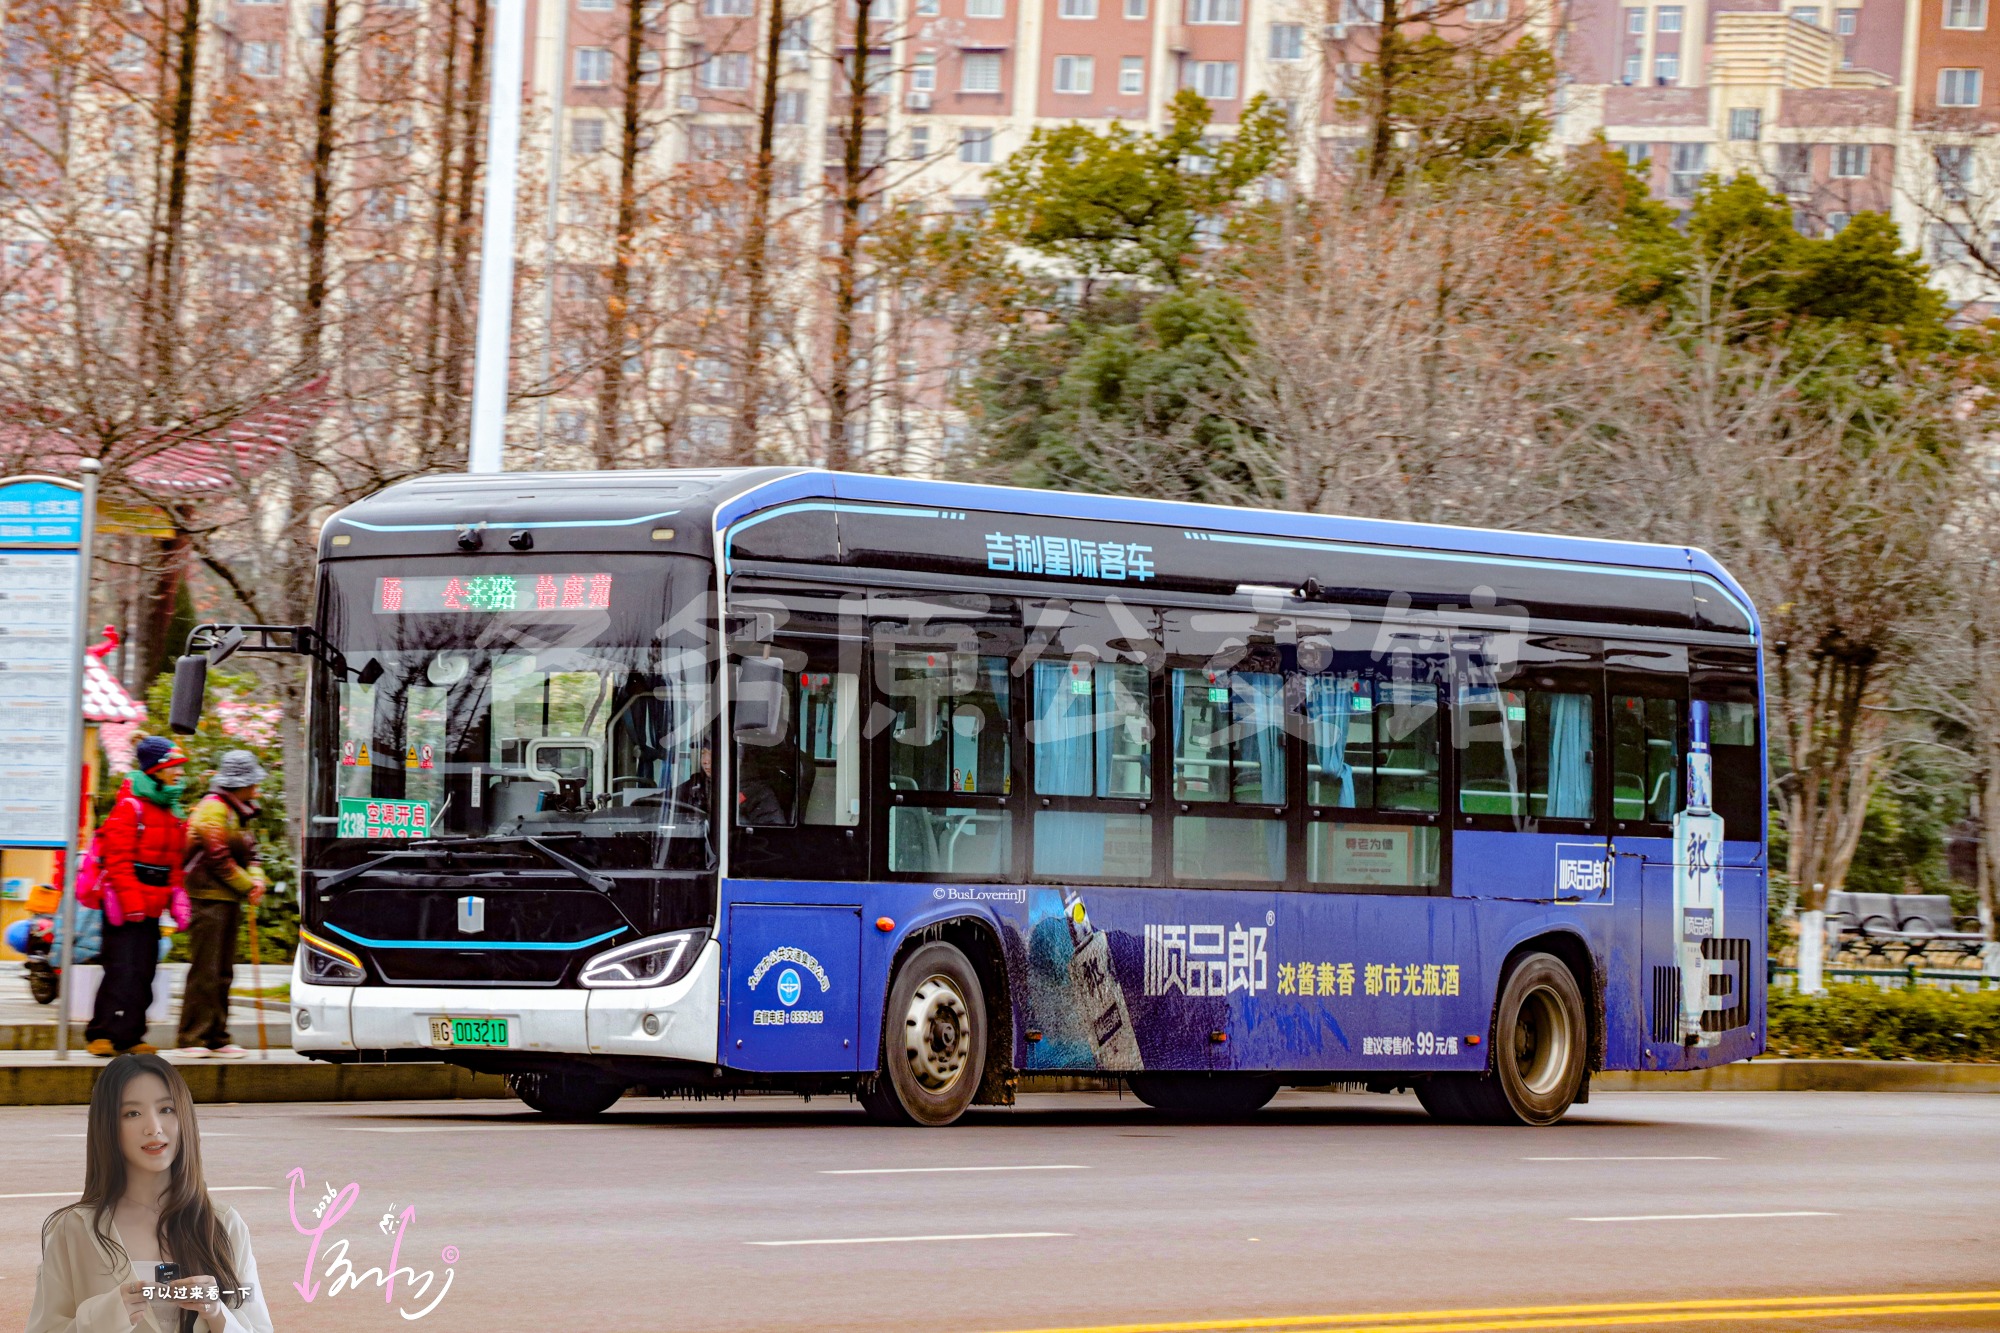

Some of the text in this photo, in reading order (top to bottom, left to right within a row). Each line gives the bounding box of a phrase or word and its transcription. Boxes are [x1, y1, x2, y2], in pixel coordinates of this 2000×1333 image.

[985, 531, 1155, 582] 吉利星际客车
[366, 802, 426, 827] 空调开启
[1559, 859, 1610, 890] 顺品郎
[1684, 916, 1713, 936] 顺品郎
[1144, 922, 1267, 997] 顺品郎
[1277, 962, 1460, 996] 浓酱兼香 都市光瓶酒
